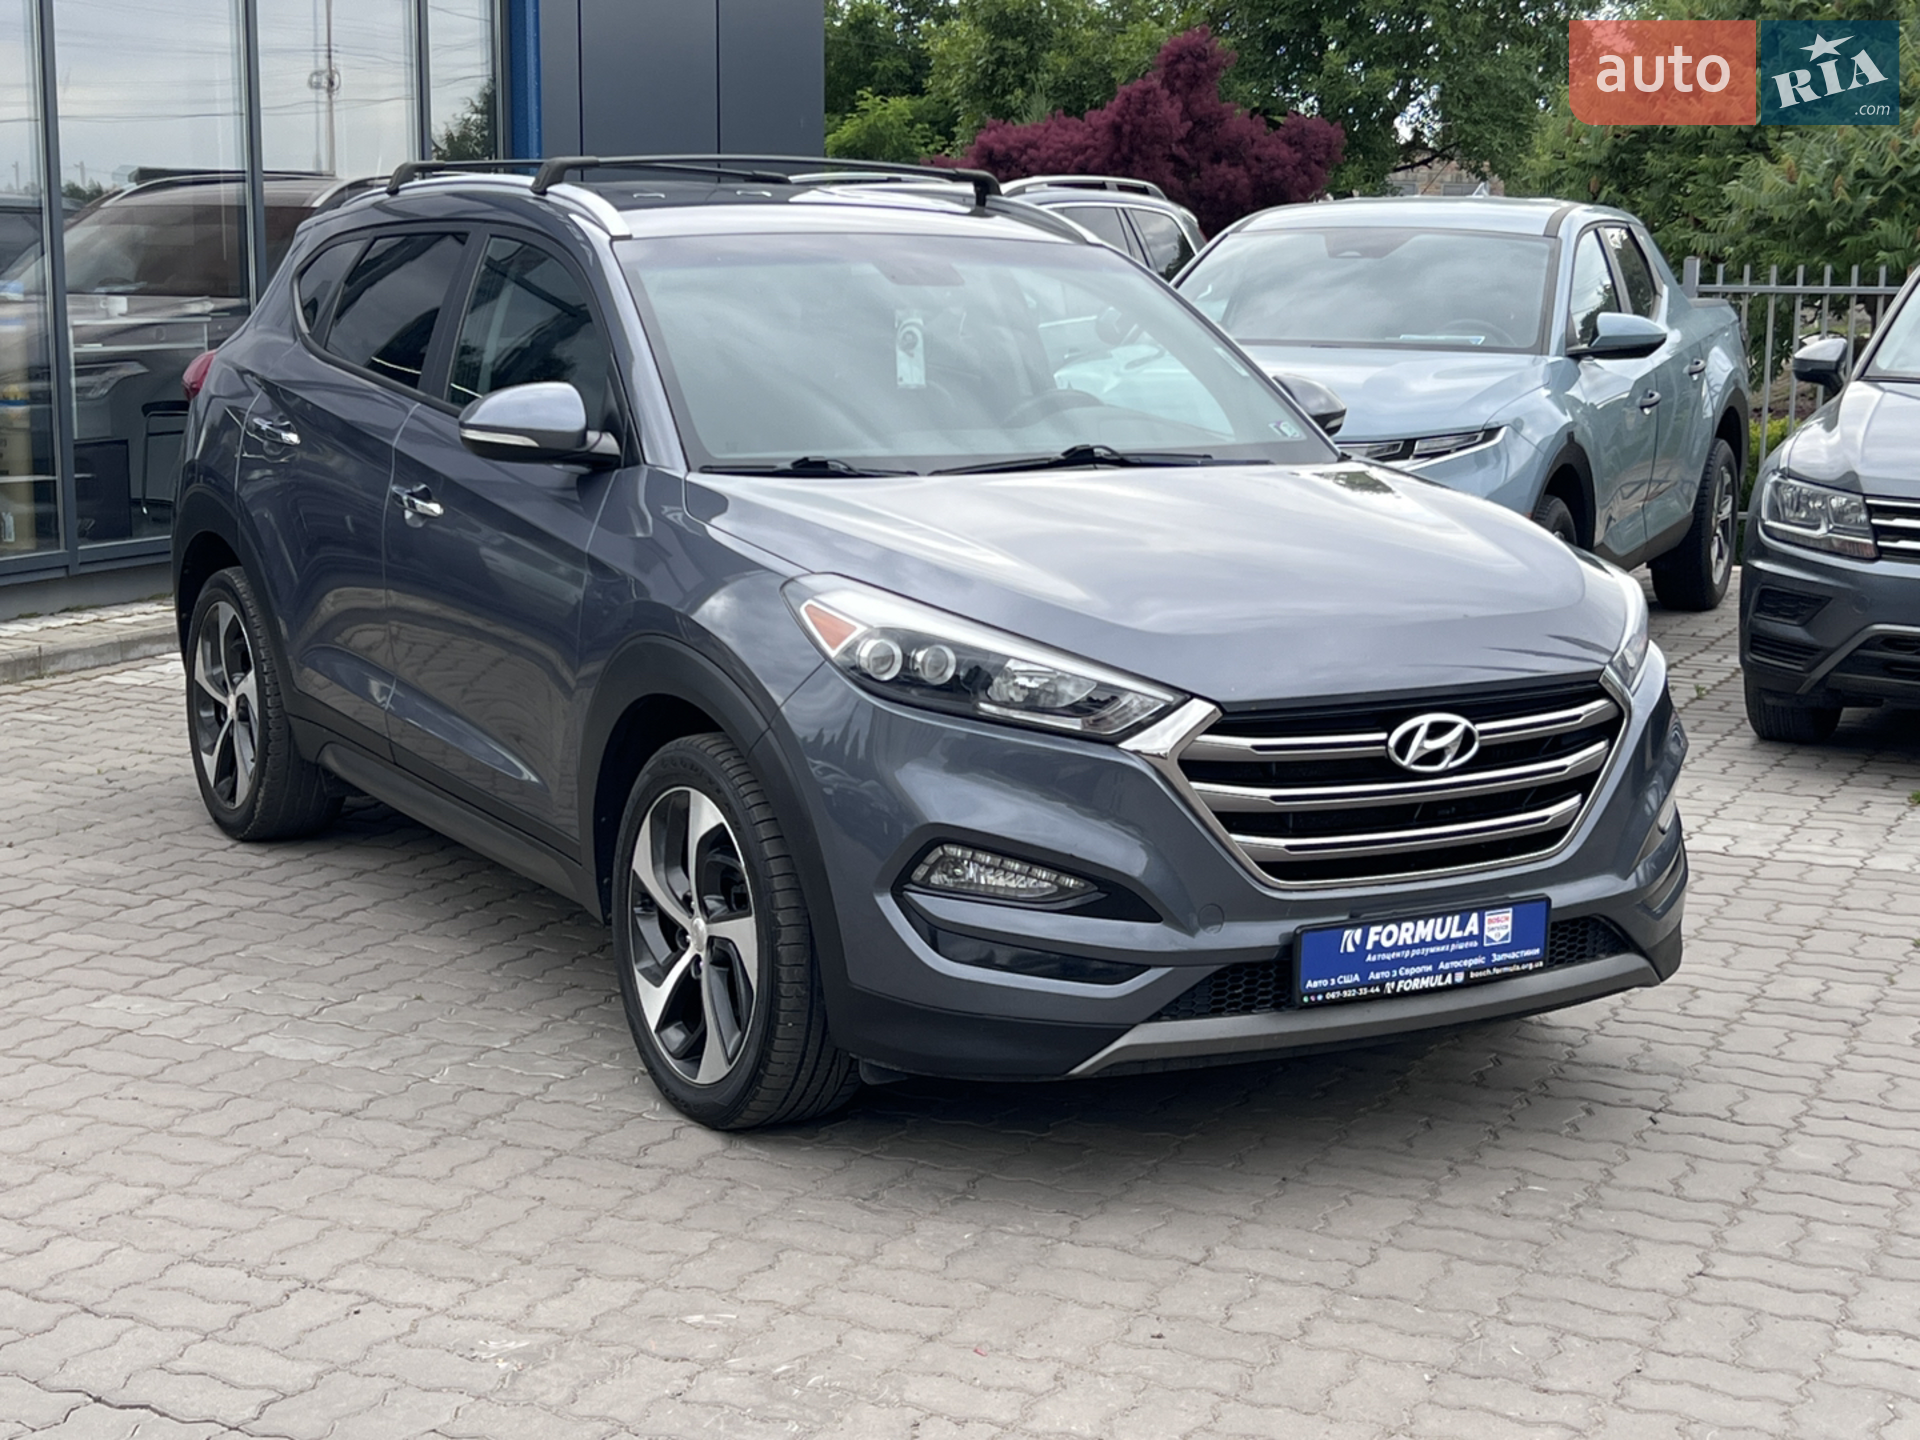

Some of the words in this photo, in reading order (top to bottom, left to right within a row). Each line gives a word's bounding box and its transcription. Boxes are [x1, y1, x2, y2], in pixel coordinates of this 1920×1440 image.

[1365, 912, 1479, 950] FORMULA
[1487, 915, 1510, 925] BOSCH
[1305, 979, 1329, 989] Авто
[1337, 973, 1360, 985] США
[1368, 970, 1391, 980] Авто
[1398, 964, 1433, 976] Європи
[1491, 948, 1541, 963] Запчастини
[1396, 973, 1453, 993] FORMULA
